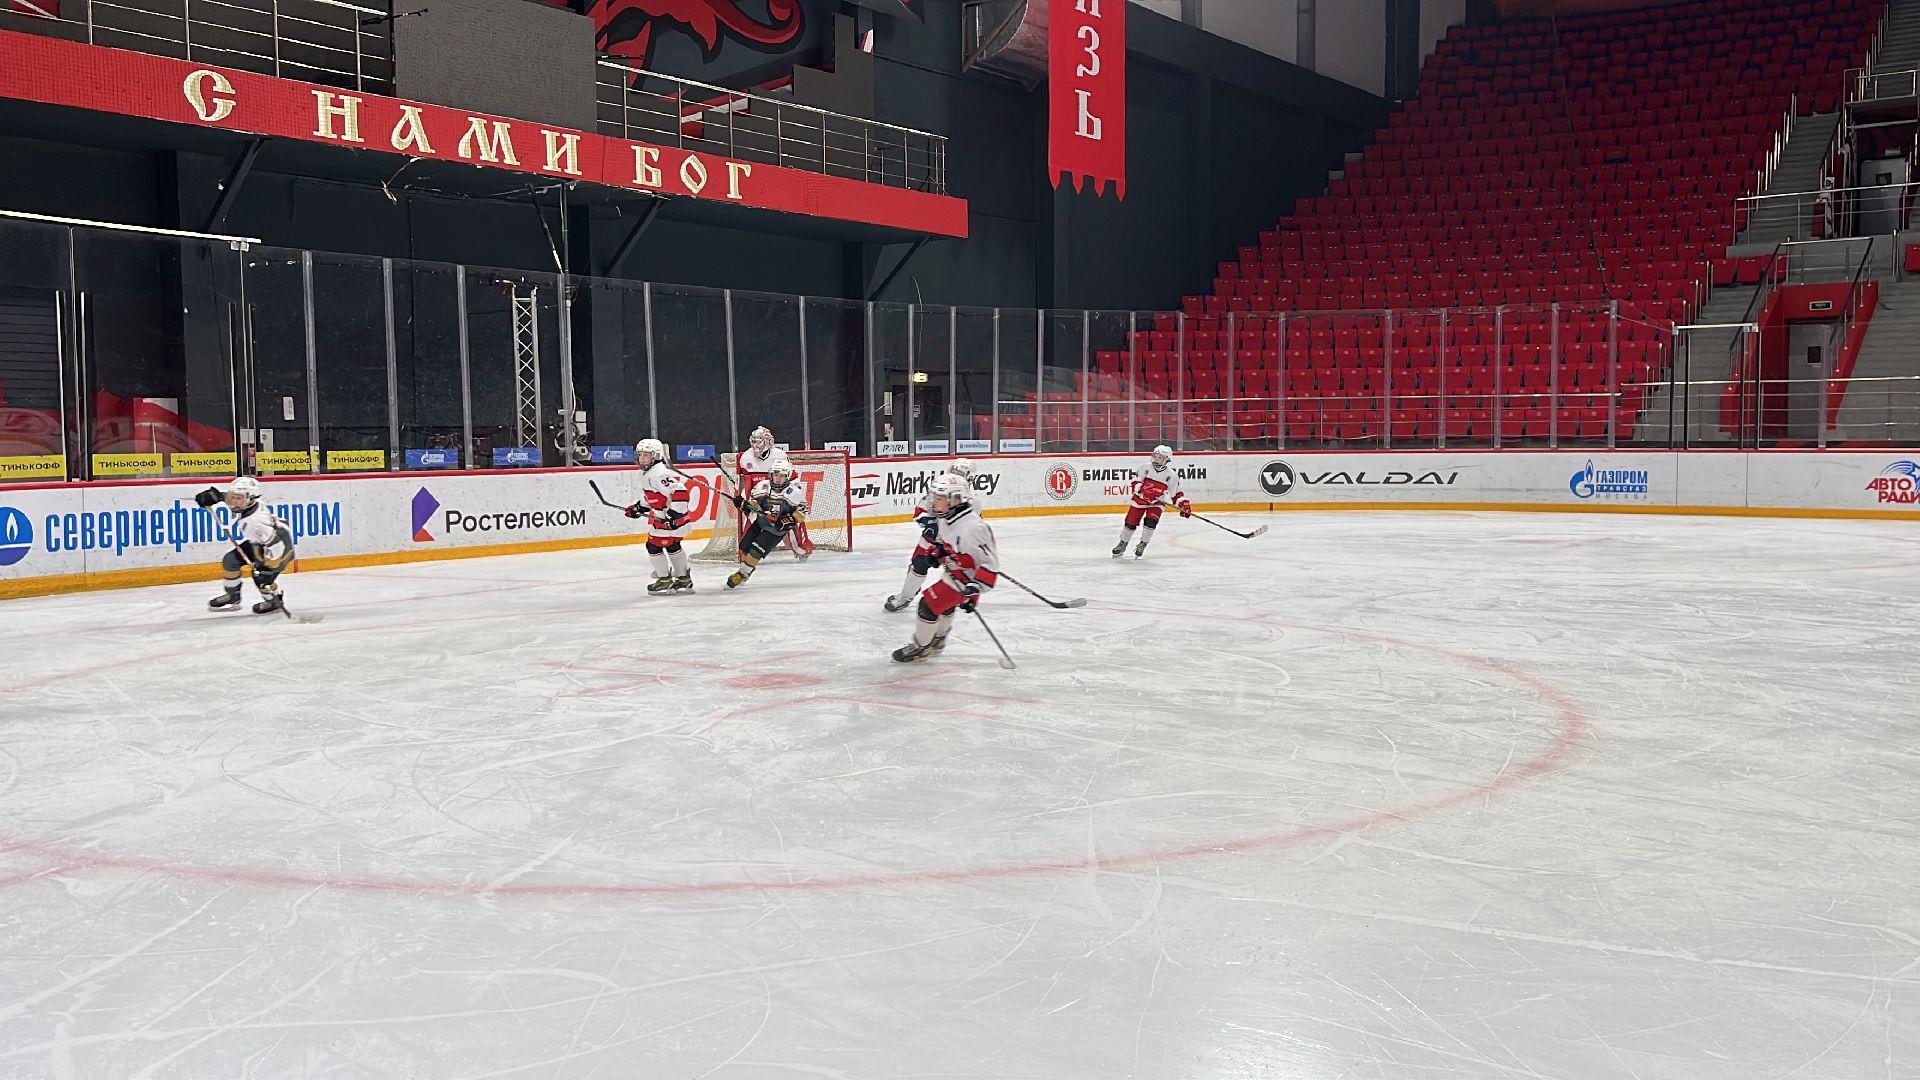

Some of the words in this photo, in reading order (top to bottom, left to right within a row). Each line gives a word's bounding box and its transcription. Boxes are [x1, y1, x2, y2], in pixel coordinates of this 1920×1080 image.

[184, 70, 237, 122] С
[311, 89, 583, 176] НАМИ
[630, 145, 752, 200] БОГ
[98, 459, 157, 469] ТИНЬКОФФ
[177, 458, 232, 467] ТИНЬКОФФ
[332, 455, 380, 464] ТИНЬКОФФ
[1, 462, 60, 472] ТИНЬКОФФ
[1299, 471, 1459, 485] VALDAI
[1596, 470, 1648, 484] ГАЗПРОМ
[1864, 478, 1912, 491] АВТО
[445, 509, 586, 534] Ростелеком
